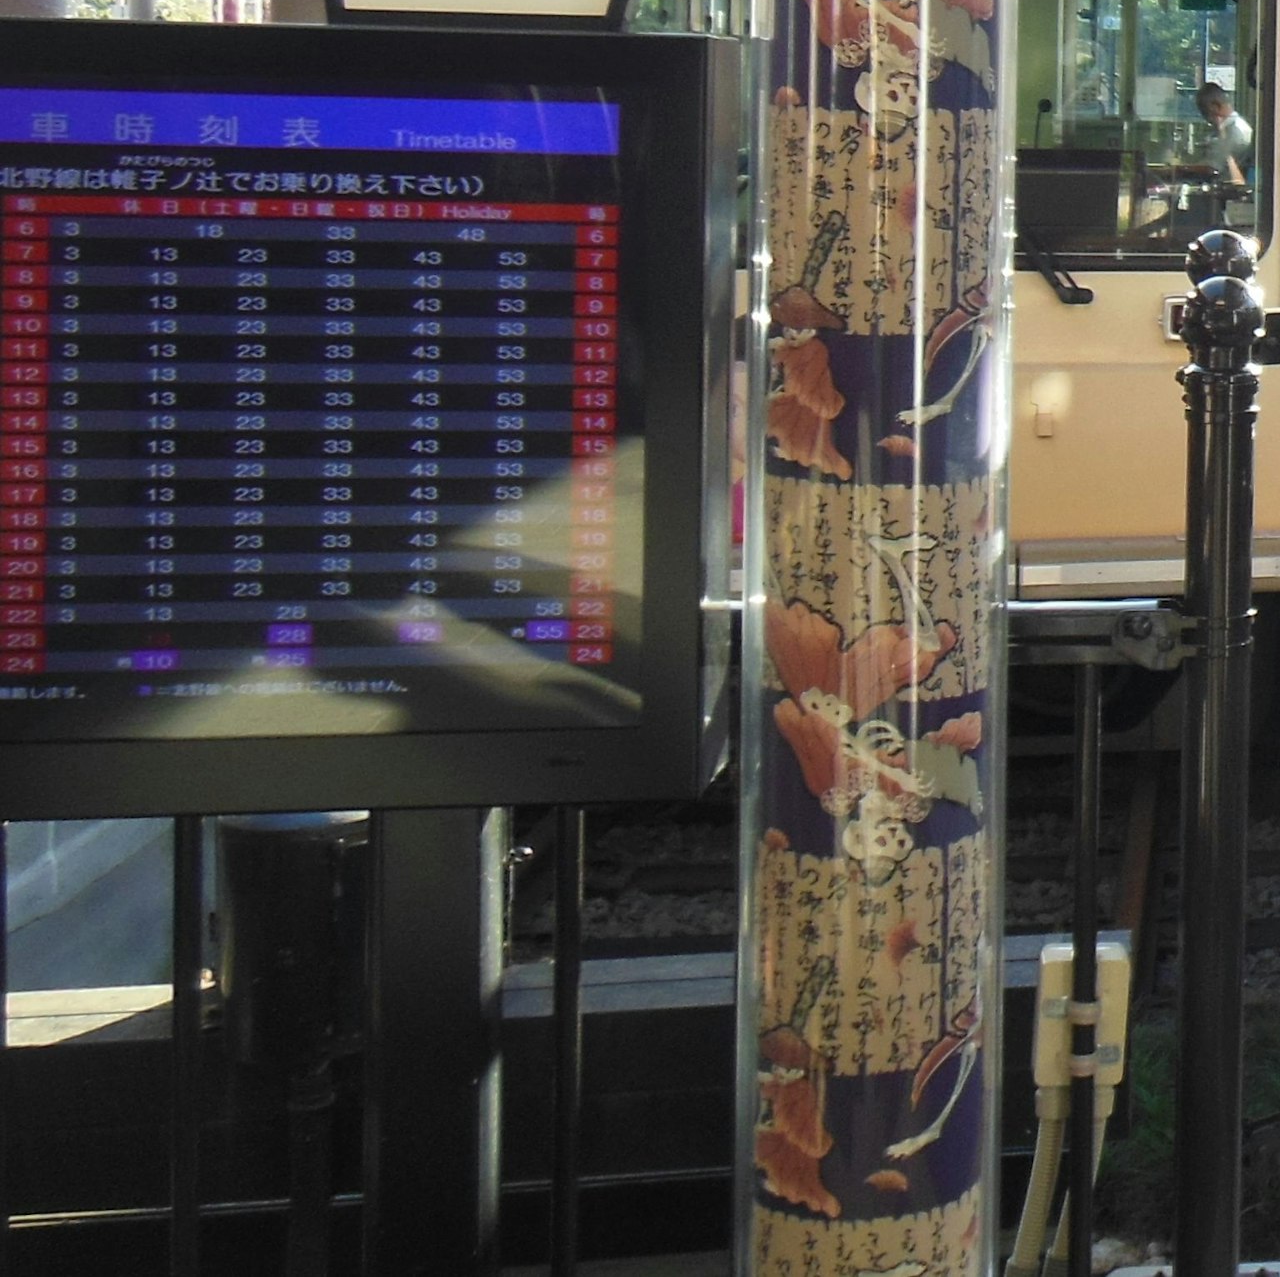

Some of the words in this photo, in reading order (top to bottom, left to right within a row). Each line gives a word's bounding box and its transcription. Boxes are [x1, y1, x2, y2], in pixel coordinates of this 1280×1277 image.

[390, 129, 518, 150] Timetable
[442, 205, 512, 222] Holiday
[18, 221, 35, 236] 6
[64, 221, 80, 236] 3
[196, 224, 224, 238] 18
[326, 225, 356, 240] 33
[457, 228, 485, 242] 48
[589, 229, 605, 244] 6
[21, 245, 34, 260] 7
[64, 245, 80, 261] 3
[151, 247, 178, 262] 13
[238, 248, 268, 263] 23
[326, 249, 356, 264] 33
[413, 251, 442, 265] 43
[499, 251, 527, 266] 53
[591, 253, 604, 267] 7
[18, 270, 34, 284] 8
[63, 270, 80, 285] 3
[150, 271, 178, 286] 13
[237, 272, 267, 287] 23
[326, 273, 355, 288] 33
[412, 274, 442, 289] 43
[498, 275, 527, 290] 53
[589, 276, 604, 290] 8
[17, 294, 34, 309] 9
[63, 294, 80, 309] 3
[150, 295, 178, 310] 13
[237, 296, 267, 311] 23
[325, 297, 355, 312] 33
[413, 298, 441, 312] 43
[498, 298, 526, 313] 53
[589, 299, 604, 314] 9
[13, 318, 42, 333] 10
[63, 318, 79, 333] 3
[149, 319, 177, 334] 13
[236, 320, 267, 334] 23
[325, 321, 355, 335] 33
[412, 321, 441, 336] 43
[498, 322, 527, 336] 53
[584, 322, 610, 337] 10
[12, 343, 37, 357] 11
[63, 343, 79, 358] 3
[149, 343, 177, 358] 13
[237, 344, 266, 358] 23
[325, 344, 354, 359] 33
[411, 345, 441, 360] 43
[497, 345, 526, 360] 53
[584, 346, 606, 360] 11
[12, 367, 40, 381] 12
[62, 367, 79, 382] 3
[149, 367, 177, 382] 13
[236, 368, 266, 382] 23
[324, 368, 354, 383] 33
[412, 369, 440, 383] 43
[497, 369, 525, 383] 53
[584, 369, 609, 383] 12
[12, 391, 40, 405] 13
[62, 391, 78, 406] 3
[148, 391, 176, 406] 13
[236, 391, 266, 406] 23
[324, 392, 354, 406] 33
[411, 392, 440, 406] 43
[496, 392, 525, 406] 53
[583, 393, 609, 407] 13
[12, 416, 38, 429] 14
[62, 415, 78, 430] 3
[148, 415, 176, 430] 13
[235, 415, 266, 430] 23
[324, 415, 353, 430] 33
[411, 416, 440, 430] 43
[496, 415, 524, 430] 53
[583, 416, 607, 429] 14
[11, 440, 40, 454] 15
[62, 439, 78, 454] 3
[148, 439, 176, 454] 13
[235, 439, 265, 454] 23
[323, 439, 353, 454] 33
[410, 439, 439, 454] 43
[496, 439, 524, 454] 53
[582, 439, 607, 454] 15
[11, 464, 39, 478] 16
[61, 463, 77, 478] 3
[147, 463, 175, 478] 13
[234, 463, 265, 478] 23
[323, 463, 353, 477] 33
[410, 463, 439, 477] 43
[496, 462, 524, 477] 53
[11, 488, 38, 502] 17
[61, 488, 77, 502] 3
[147, 487, 175, 502] 13
[235, 487, 264, 501] 23
[323, 487, 352, 501] 33
[410, 486, 438, 500] 43
[495, 486, 524, 500] 53
[11, 512, 38, 526] 18
[60, 512, 77, 527] 3
[146, 511, 175, 525] 13
[234, 511, 264, 526] 23
[322, 510, 352, 525] 33
[410, 510, 438, 524] 43
[10, 537, 39, 551] 19
[60, 536, 77, 551] 3
[147, 535, 174, 550] 13
[234, 534, 263, 549] 23
[322, 534, 352, 548] 33
[409, 533, 438, 547] 43
[7, 561, 39, 575] 20
[60, 560, 76, 575] 3
[146, 559, 174, 574] 13
[233, 558, 263, 573] 23
[321, 557, 351, 572] 33
[409, 556, 437, 570] 43
[494, 556, 522, 570] 53
[7, 585, 34, 600] 21
[60, 584, 76, 599] 3
[146, 583, 173, 597] 13
[233, 582, 263, 597] 23
[321, 581, 351, 596] 33
[409, 580, 437, 594] 43
[494, 579, 522, 593] 53
[7, 609, 37, 624] 22
[60, 608, 75, 623] 3
[145, 607, 173, 621] 13
[276, 605, 307, 620] 28
[536, 602, 564, 616] 58
[577, 601, 605, 615] 22
[6, 633, 37, 648] 23
[277, 629, 307, 643] 28
[535, 625, 564, 639] 55
[576, 624, 605, 639] 23
[7, 657, 35, 672] 24
[145, 655, 173, 669] 10
[576, 647, 603, 662] 24
